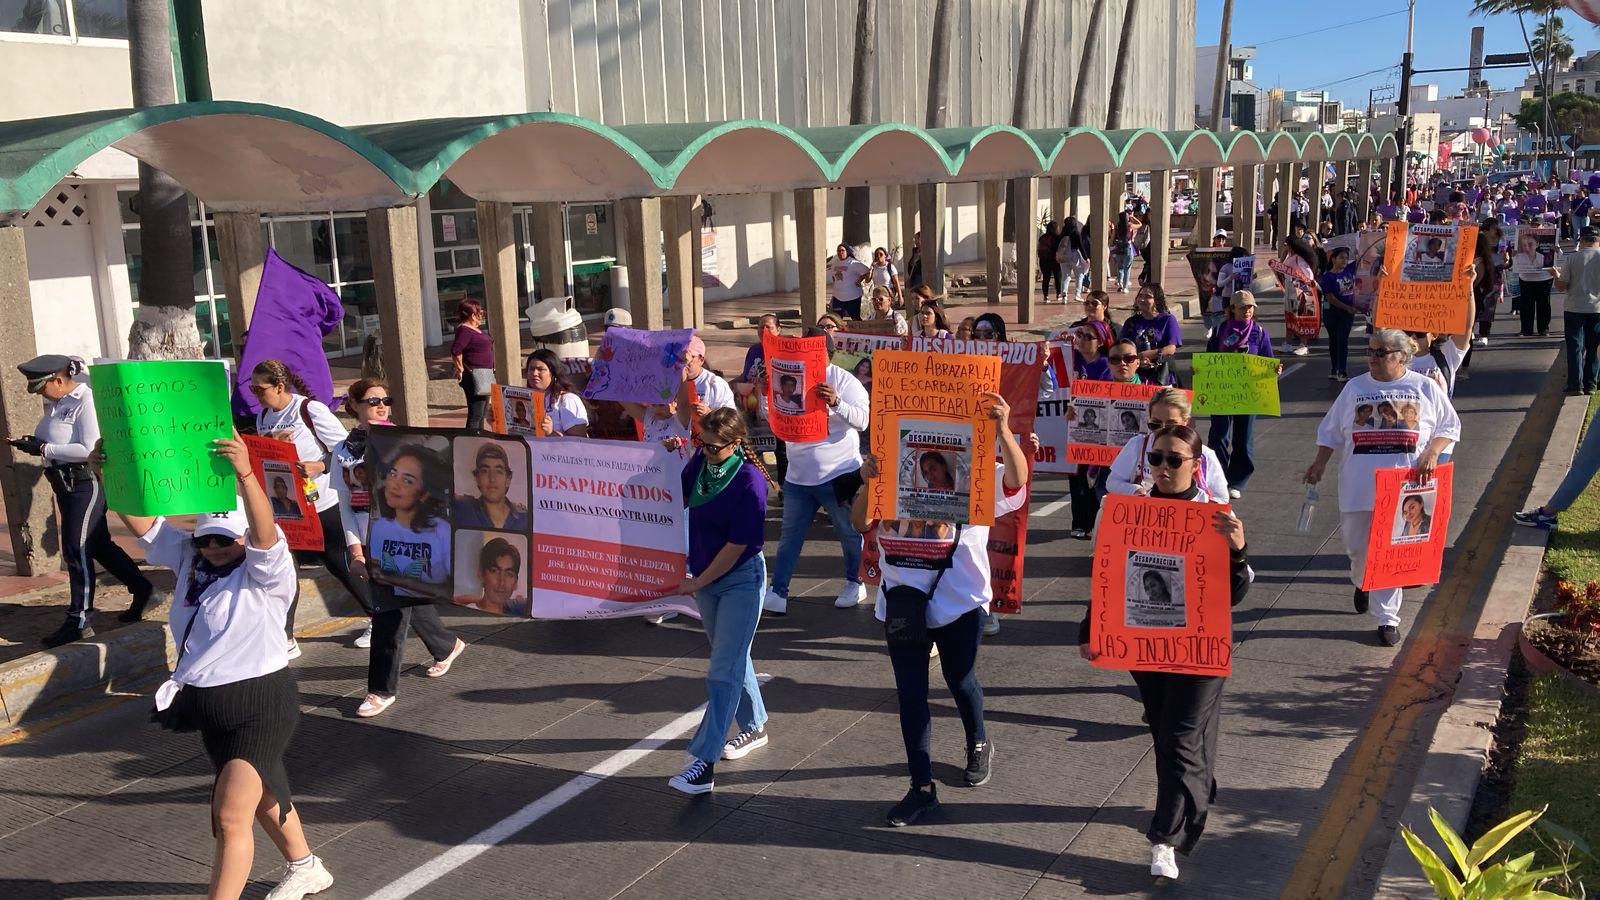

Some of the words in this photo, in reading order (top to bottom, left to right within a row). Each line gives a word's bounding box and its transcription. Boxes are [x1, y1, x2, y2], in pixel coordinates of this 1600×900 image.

[878, 358, 919, 374] QUIERO
[925, 355, 996, 382] ABRAZARLA!
[878, 376, 894, 389] NO
[901, 377, 966, 394] ESCARBAR
[969, 382, 998, 398] PARA
[1105, 383, 1115, 397] SE
[1120, 385, 1138, 398] LOS
[884, 394, 983, 416] ENCONTRARLA
[908, 434, 962, 445] DESAPARECIDA
[541, 454, 556, 463] NOS
[557, 455, 583, 465] FALTAS
[596, 459, 611, 469] NOS
[611, 461, 635, 471] FALTAN
[637, 464, 662, 473] TODOS
[873, 414, 886, 519] JUSTICIA
[974, 418, 988, 517] JUSTICIA
[142, 459, 228, 504] Aguilar
[536, 472, 673, 504] DESAPARECIDOS
[539, 500, 587, 513] AYUDANOS
[588, 506, 594, 514] A
[595, 506, 674, 525] ENCONTRARLOS
[1112, 502, 1177, 530] OLVIDAR
[1184, 507, 1206, 535] ES
[1123, 526, 1196, 553] PERMITIR
[537, 544, 565, 555] LIZETH
[566, 547, 605, 561] BERENICE
[606, 553, 638, 566] NIEBLAS
[639, 558, 676, 573] LEDEZMA
[548, 559, 566, 569] JOSE
[567, 562, 599, 573] ALFONSO
[601, 567, 633, 579] ASTORGA
[634, 573, 665, 585] NIEBLAS
[1134, 554, 1177, 566] DESAPARECIDA
[541, 572, 576, 585] ROBERTO
[576, 578, 605, 589] ALONSO
[607, 583, 639, 596] ASTORGA
[1194, 555, 1206, 633] JUSTICIA
[1098, 633, 1128, 659] LAS
[1133, 634, 1231, 667] INJUSTICIAS
